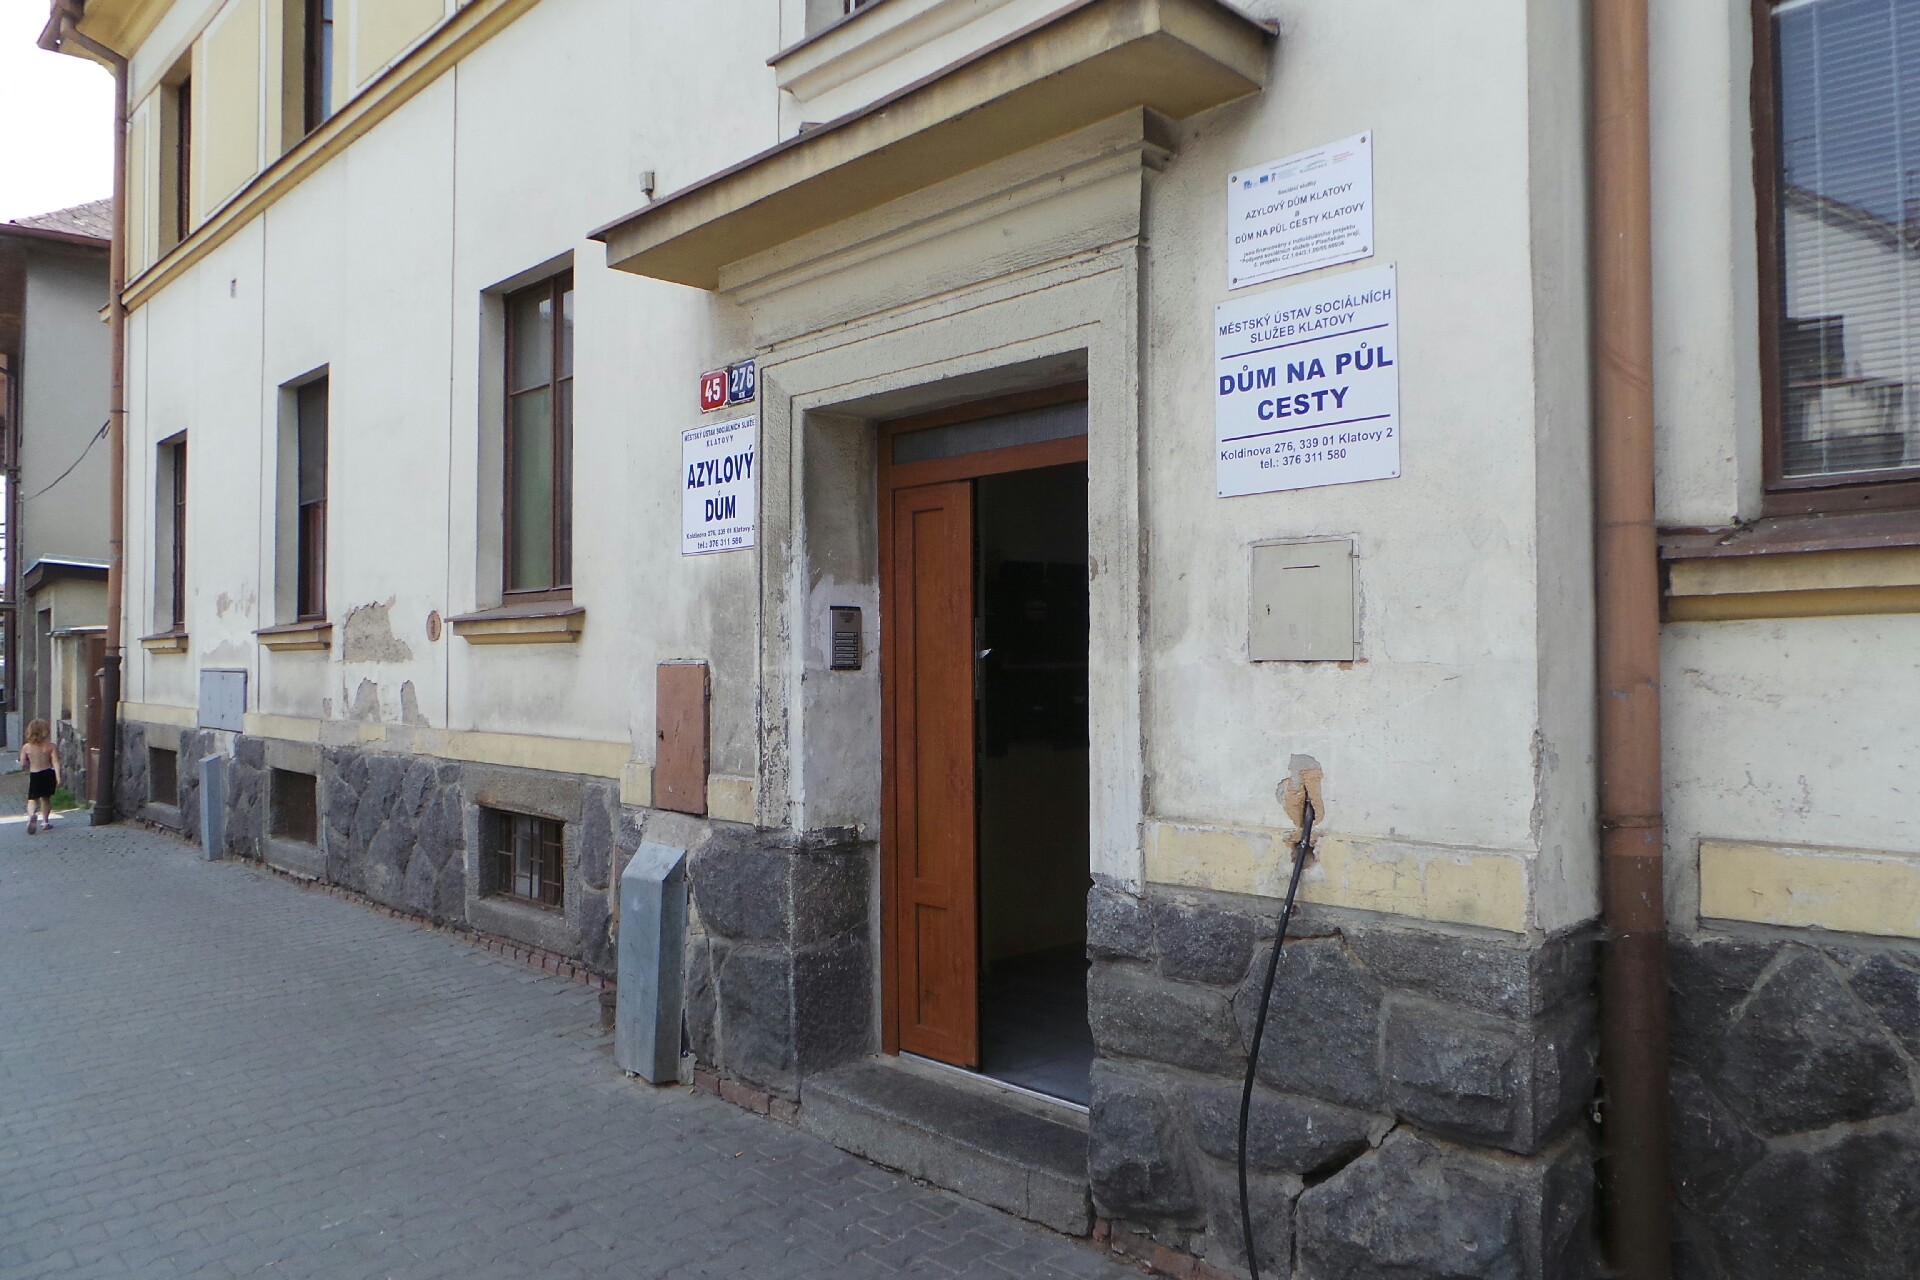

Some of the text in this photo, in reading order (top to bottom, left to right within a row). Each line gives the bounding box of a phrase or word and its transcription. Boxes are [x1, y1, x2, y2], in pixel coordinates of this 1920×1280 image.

[1245, 183, 1353, 220] AZYLOVÝ DŮM KLATOVY
[1235, 202, 1365, 244] DŮM NA PŮL CESTY KLATOVY
[1332, 224, 1356, 234] projektu
[1219, 289, 1391, 336] MĚSTSKÝ ÚSTAV SOCIÁLNÍCH
[1250, 312, 1355, 343] SLUŽEB KLATOVY
[731, 365, 753, 392] 276
[1219, 342, 1393, 396] DŮM NA PŮL
[705, 378, 720, 402] 45
[1257, 386, 1350, 420] CESTY
[684, 431, 702, 442] MĚSTSKÝ
[703, 428, 715, 438] ÚSTAV
[716, 423, 740, 434] SOCIÁLNÍCH
[707, 435, 734, 447] KLATOVY
[1221, 427, 1393, 460] Koldinova 276, 339 01 Klatovy 2
[687, 445, 754, 490] AZYLOVÝ
[1260, 448, 1347, 469] tel.: 376 311 580
[705, 490, 736, 522] DŮM
[698, 541, 707, 549] tel.:
[709, 540, 718, 548] 376
[720, 538, 729, 546] 311
